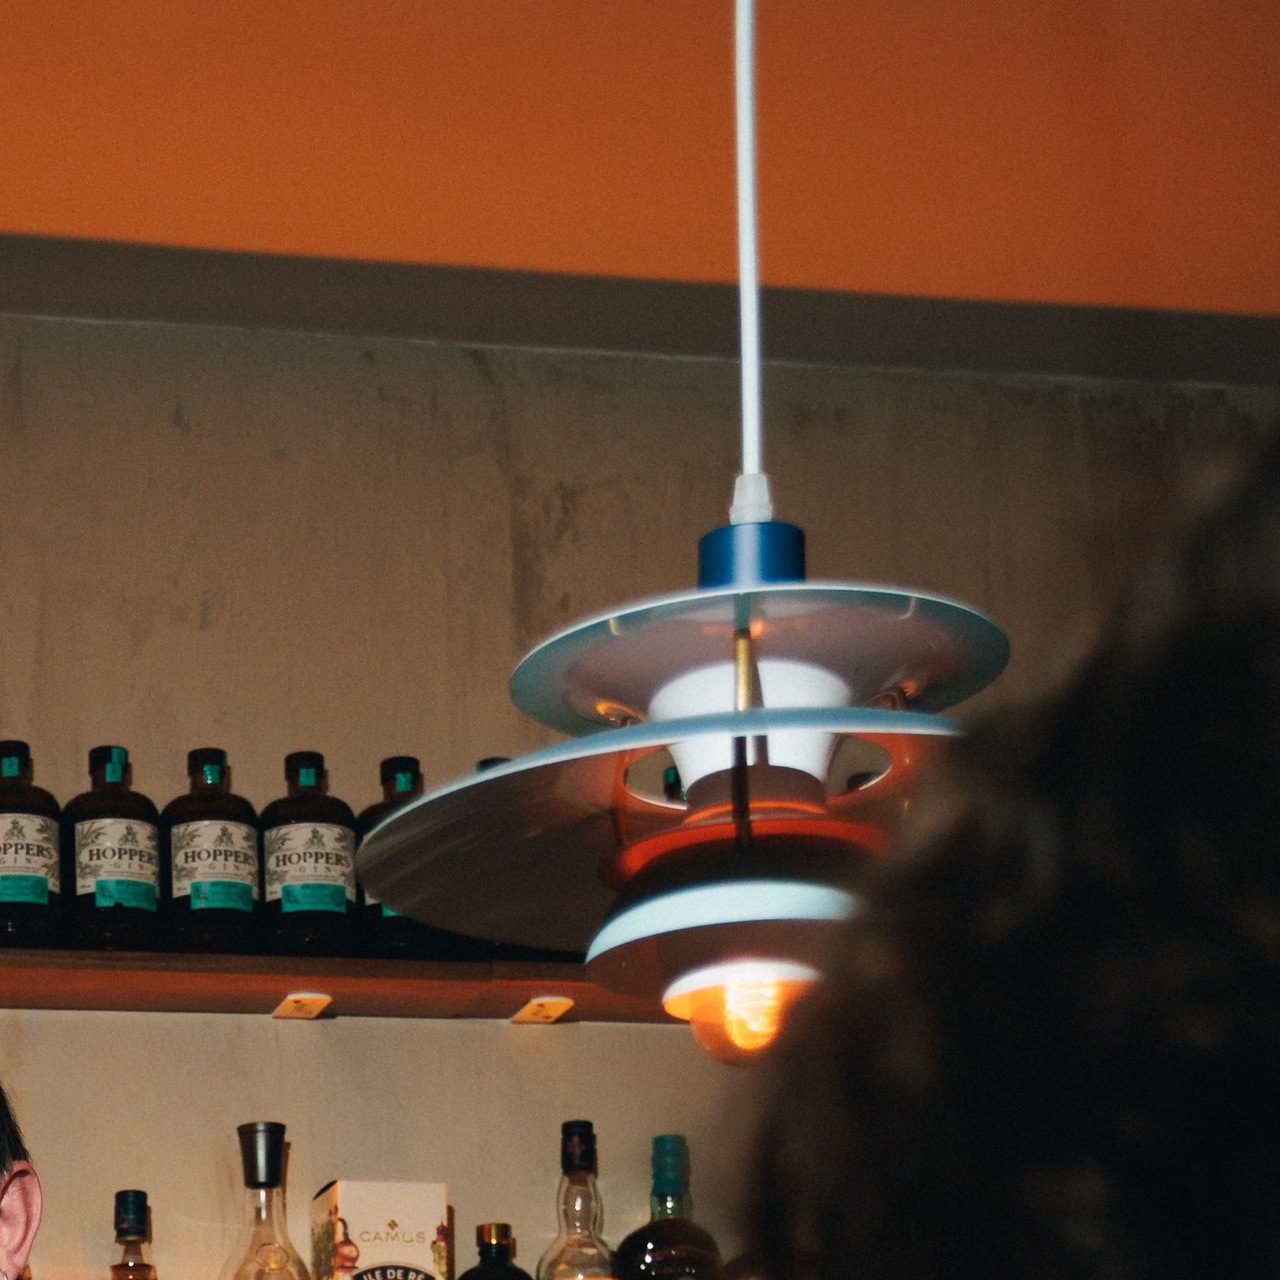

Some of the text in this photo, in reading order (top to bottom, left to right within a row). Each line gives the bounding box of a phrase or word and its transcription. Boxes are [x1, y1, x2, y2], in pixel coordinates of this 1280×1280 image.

[275, 851, 351, 868] HOPPERS
[359, 1231, 426, 1243] CAMUS
[386, 1269, 404, 1280] DE
